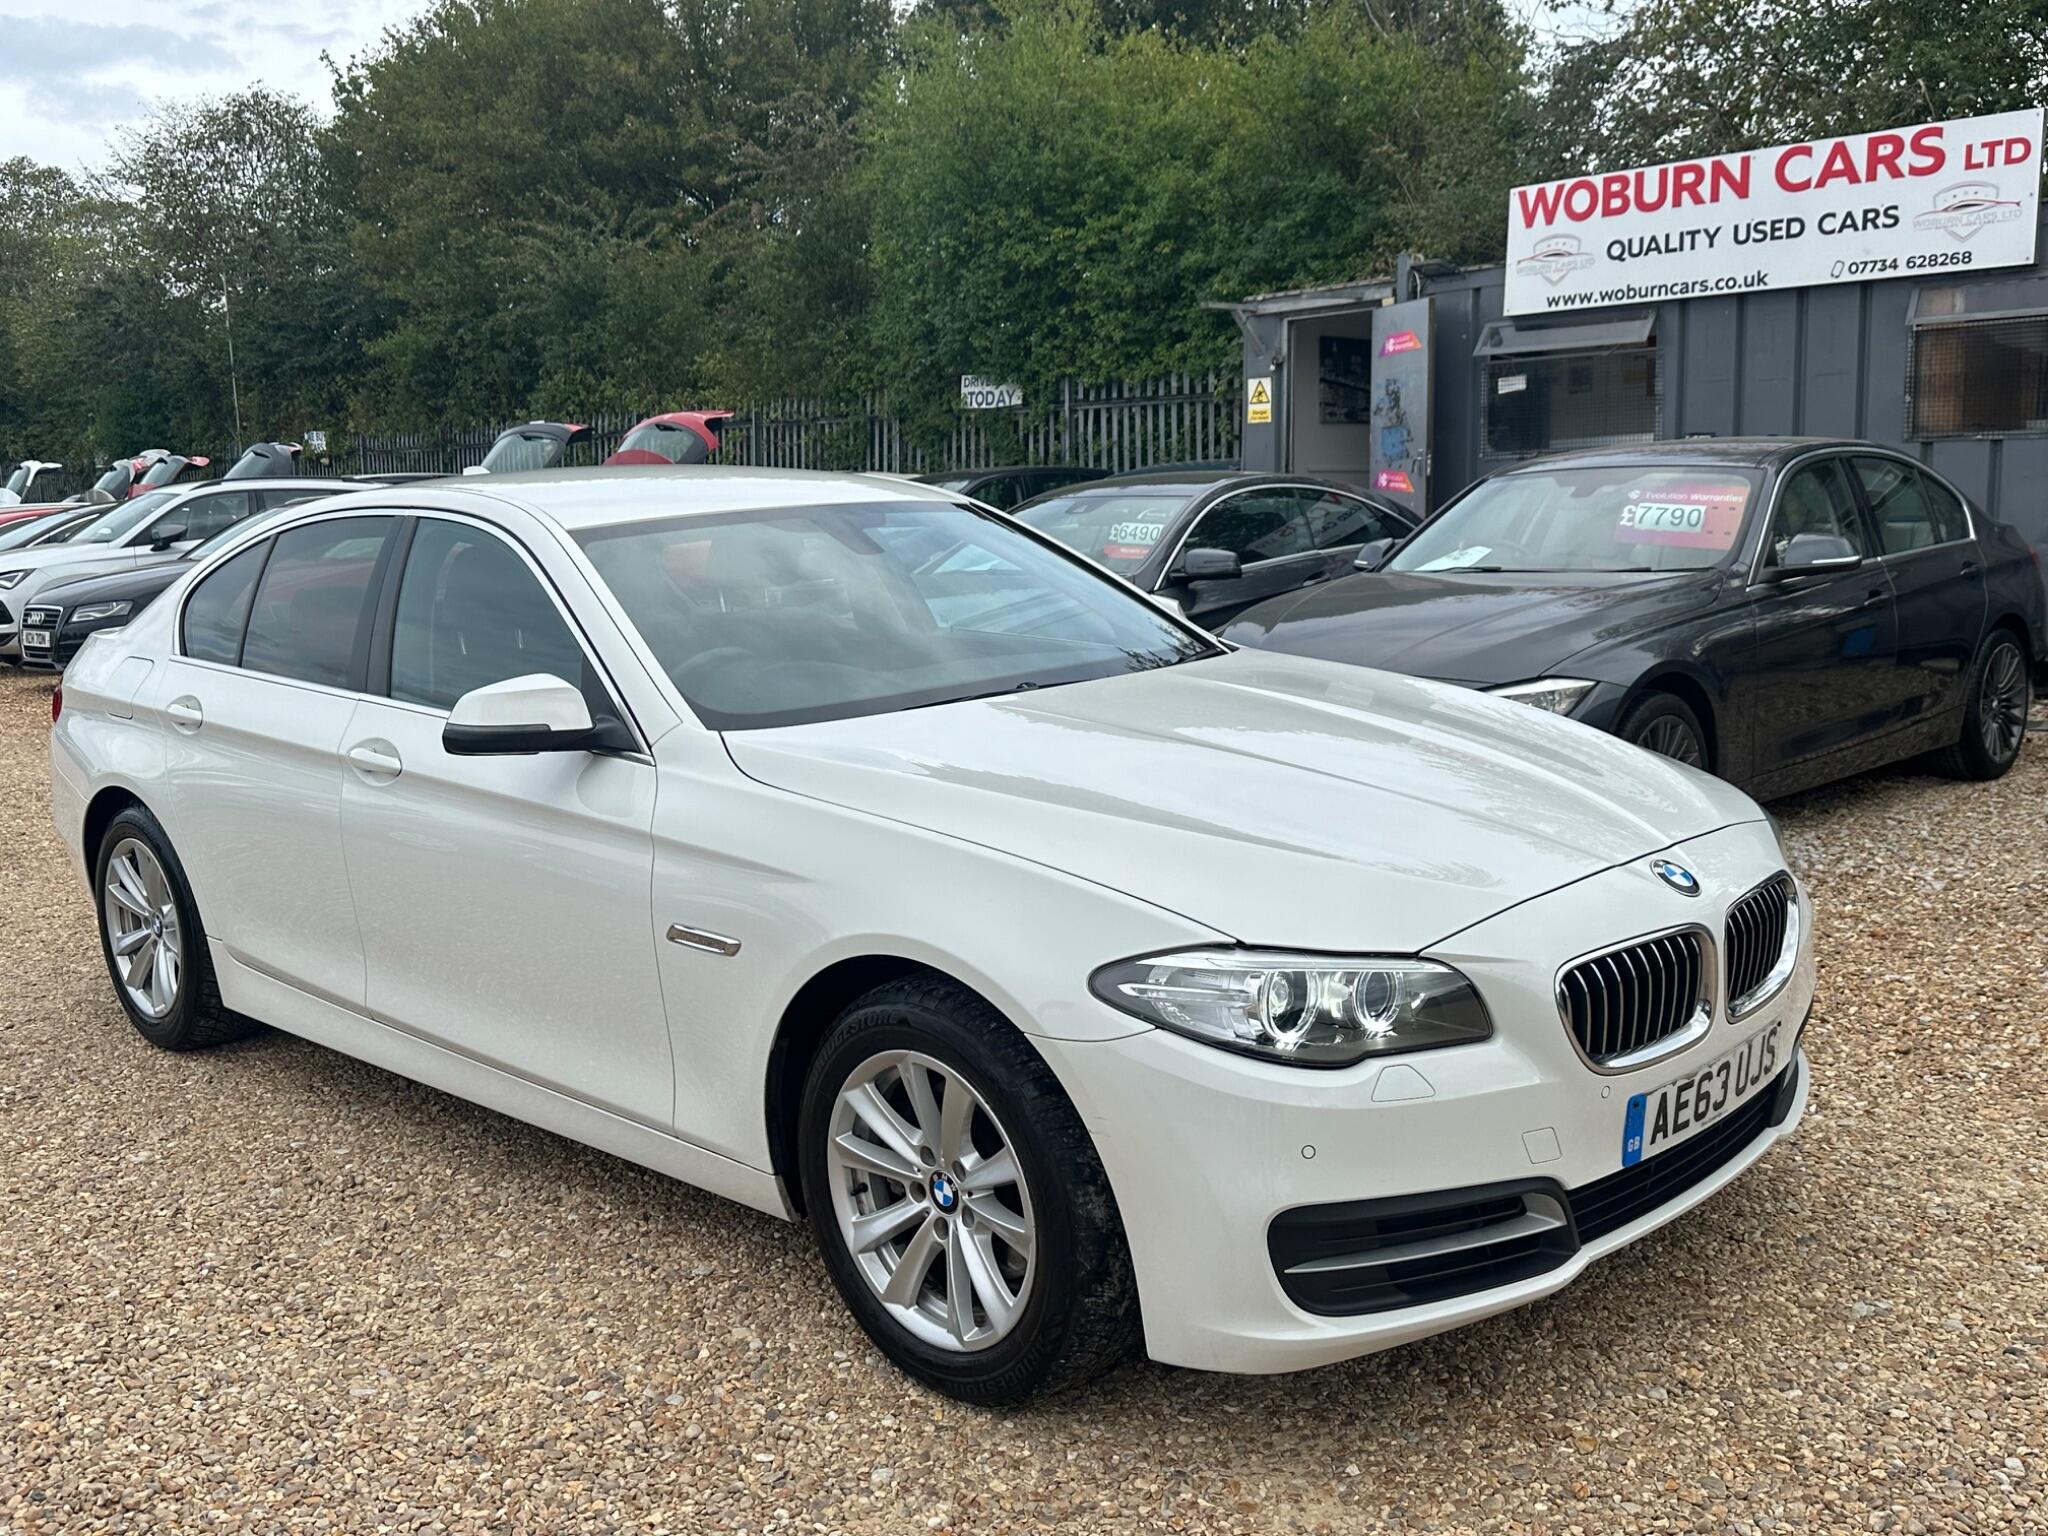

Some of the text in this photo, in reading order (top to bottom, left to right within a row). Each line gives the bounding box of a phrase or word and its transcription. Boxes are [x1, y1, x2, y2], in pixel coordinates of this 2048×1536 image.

[1518, 126, 2032, 228] WOBURN CARS LTD
[1606, 206, 1900, 262] QUALITY USED CARS
[1847, 250, 1973, 275] 07734 628268
[1546, 270, 1769, 308] www.woburncars.co.uk
[968, 390, 1016, 407] TODAY
[1646, 491, 1743, 503] Evolution Warranties
[1619, 504, 1702, 528] £7790
[1108, 524, 1160, 541] £6490
[1649, 1026, 1779, 1146] AE63 UJS
[1627, 1136, 1640, 1152] GB
